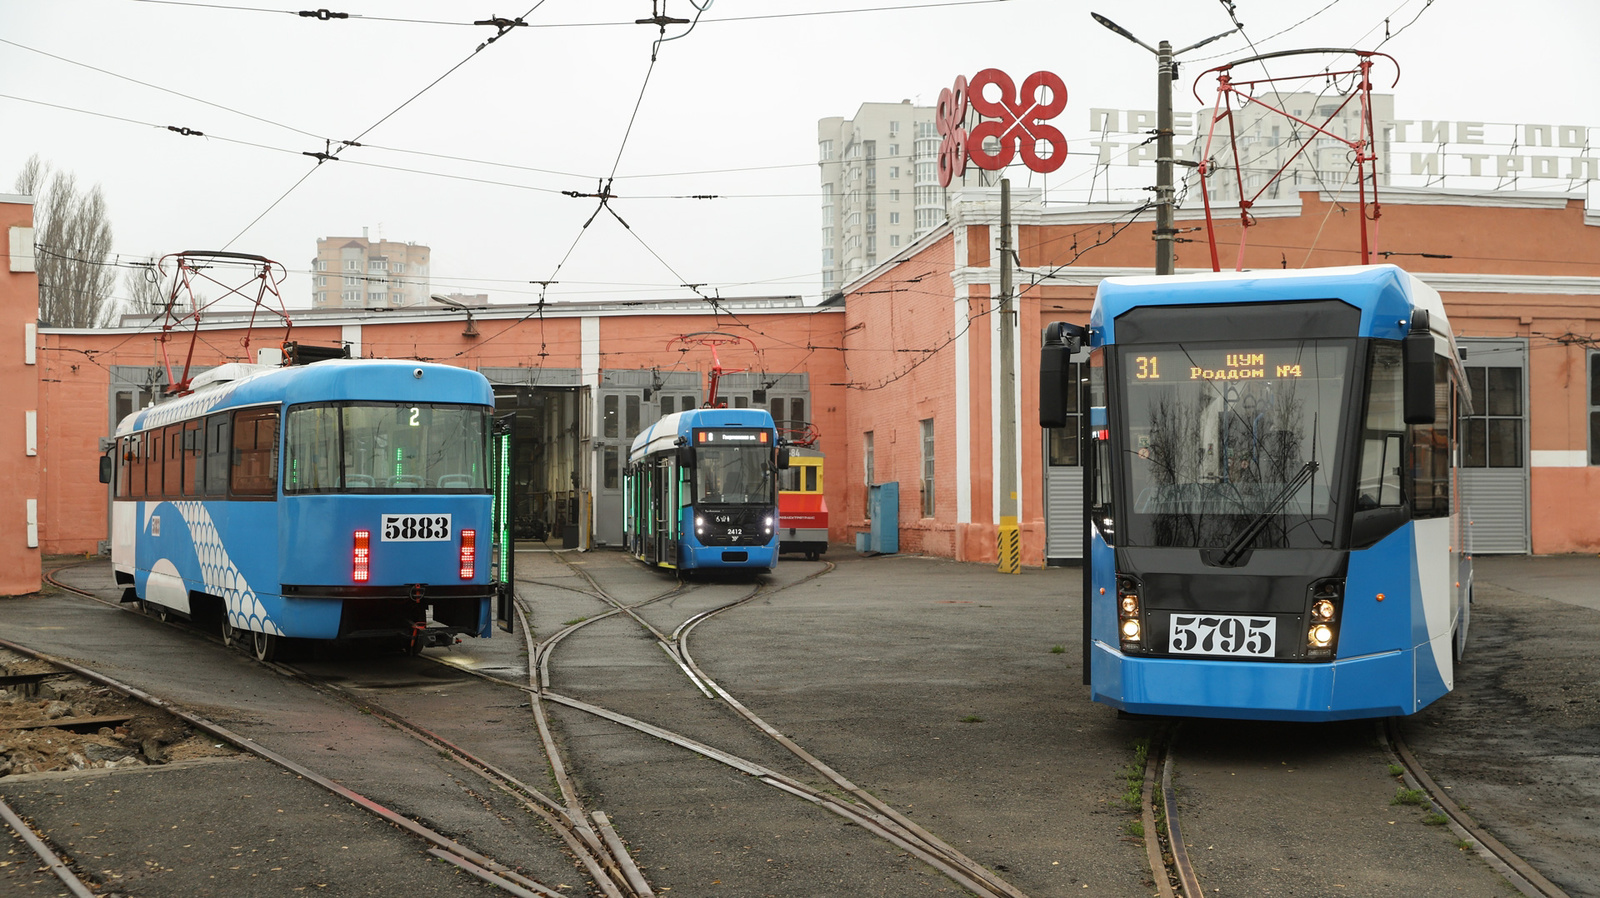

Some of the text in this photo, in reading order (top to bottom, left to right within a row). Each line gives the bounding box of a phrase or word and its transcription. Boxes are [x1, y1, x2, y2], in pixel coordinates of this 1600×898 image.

[1525, 124, 1586, 147] ПО
[1411, 153, 1438, 175] И
[1461, 154, 1599, 180] ТРОЛ
[1136, 356, 1160, 379] 31
[1226, 353, 1264, 367] ЦУМ
[1190, 366, 1264, 380] Роддом
[409, 407, 420, 426] 2
[385, 517, 449, 540] 5883
[1172, 616, 1272, 654] 5795
